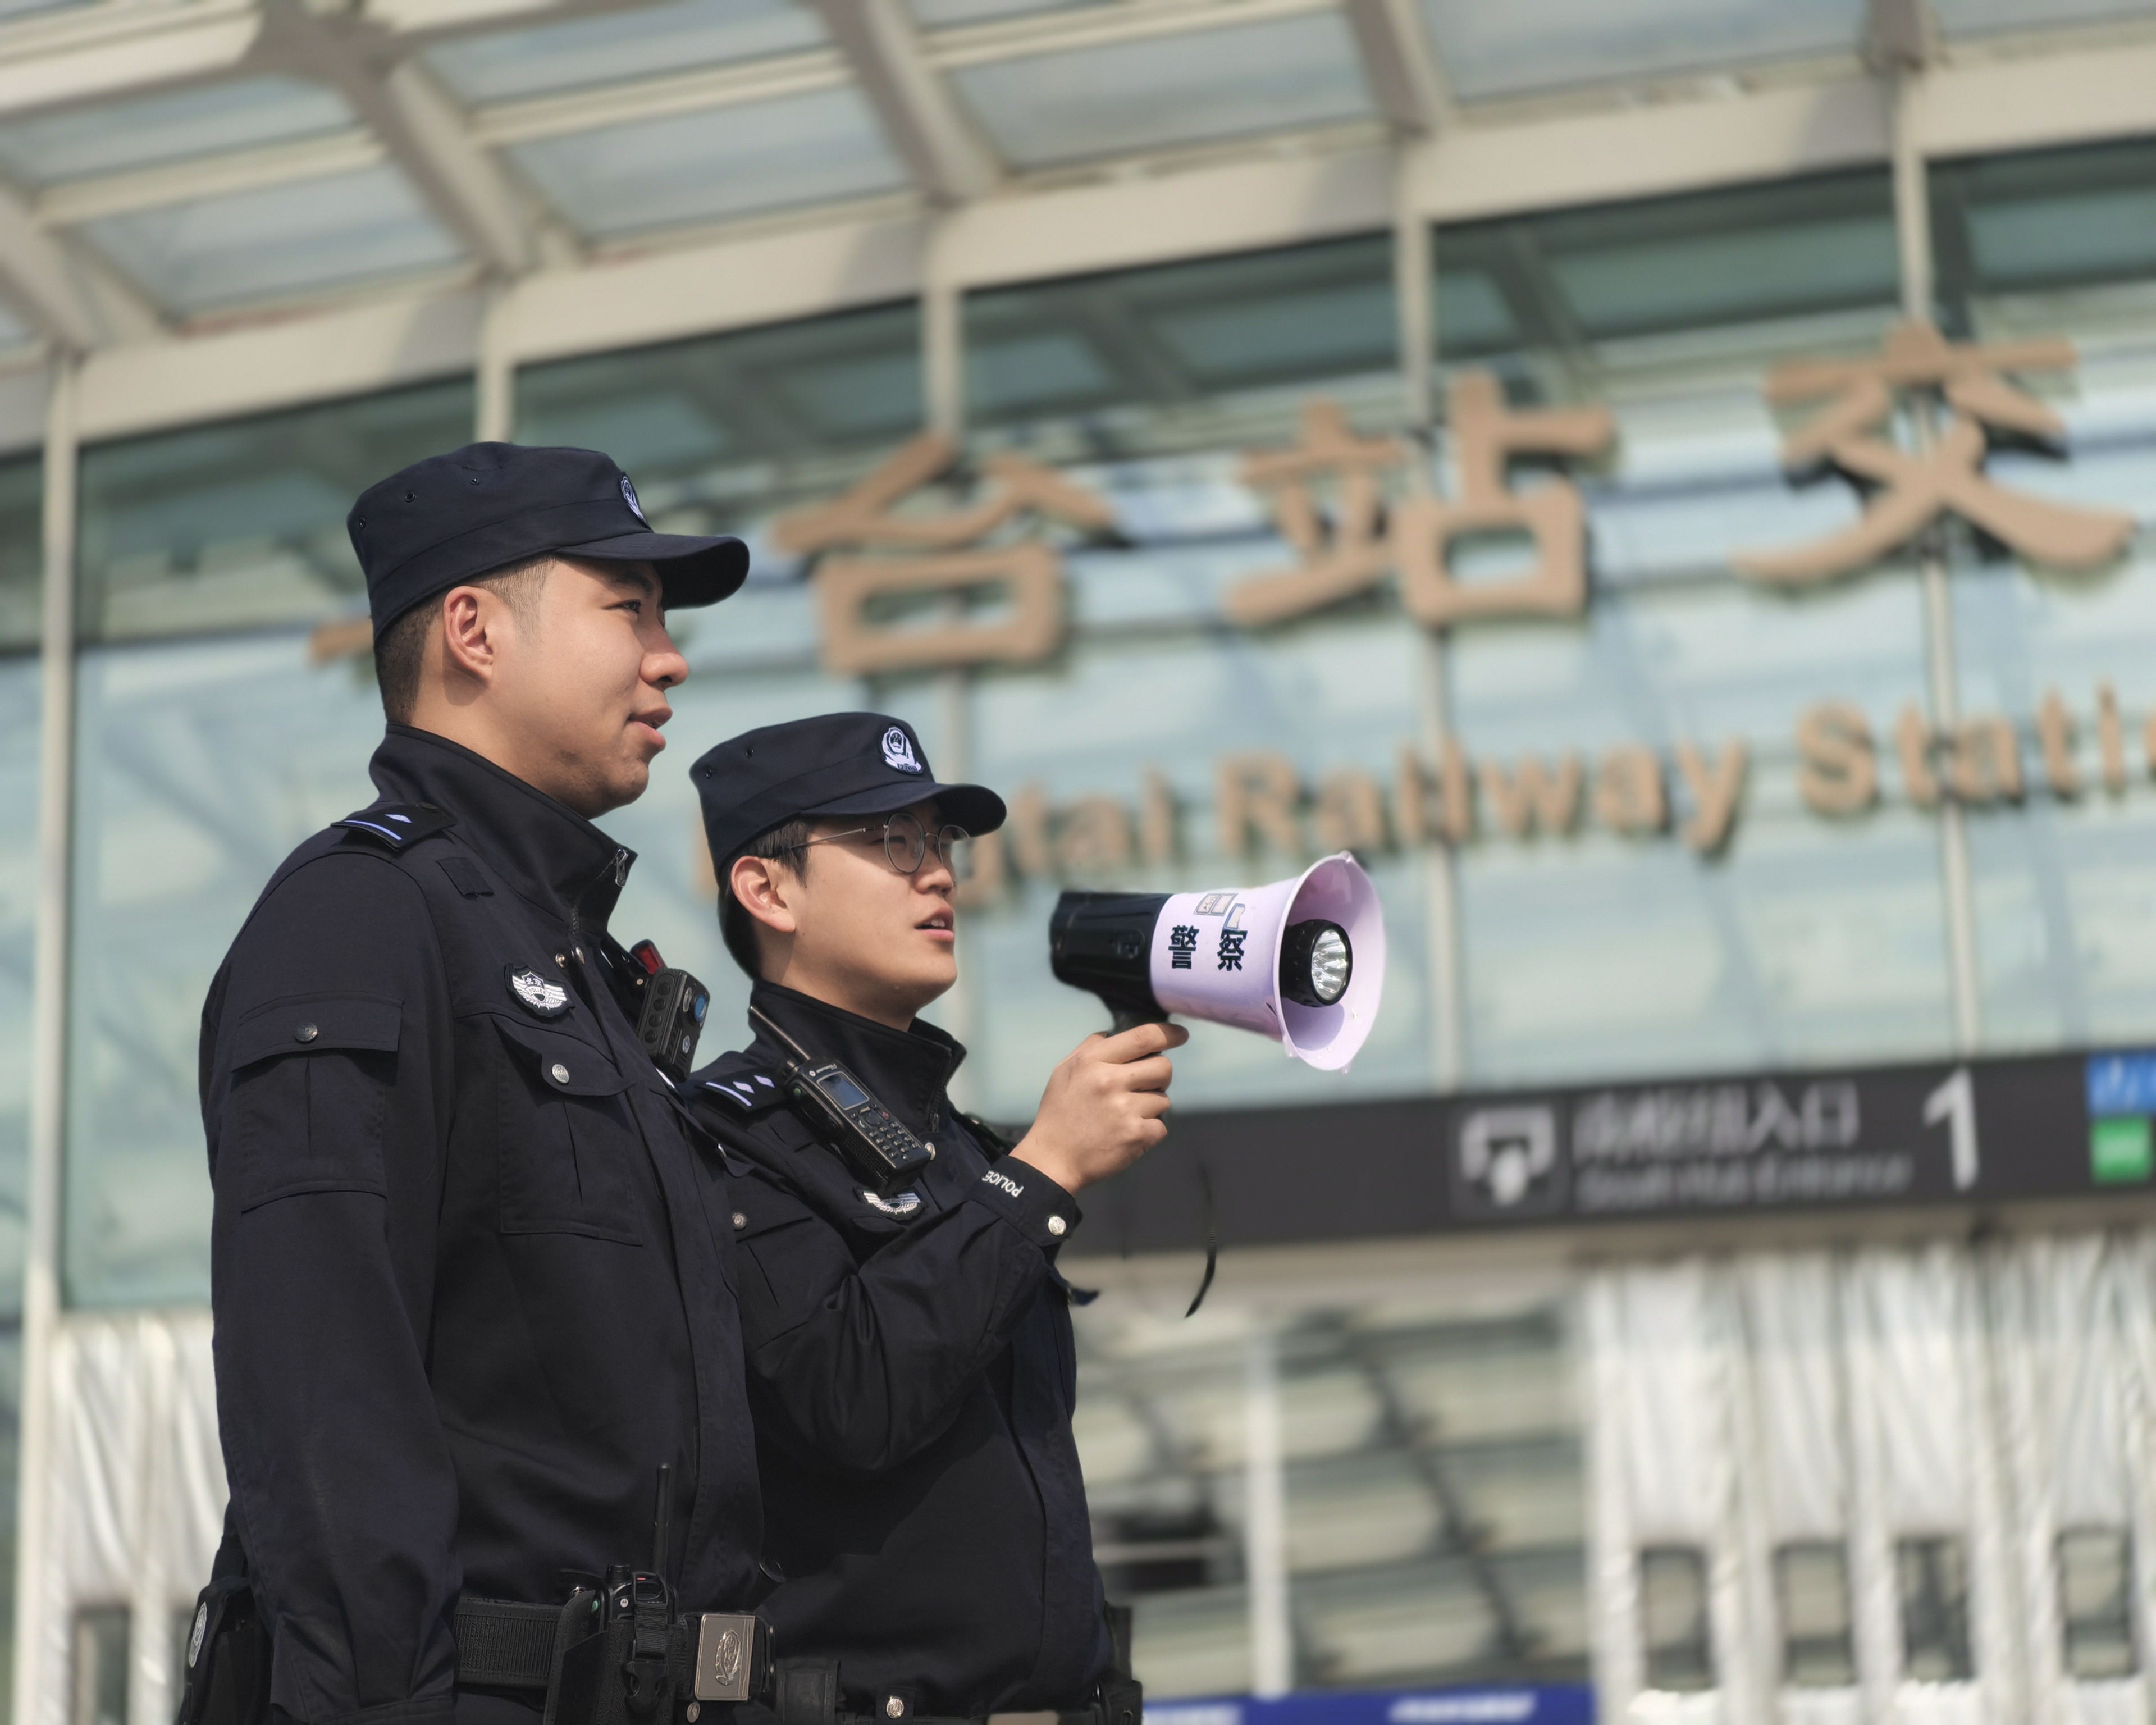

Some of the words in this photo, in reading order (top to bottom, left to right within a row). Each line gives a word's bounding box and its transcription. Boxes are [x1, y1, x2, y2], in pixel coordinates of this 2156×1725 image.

[310, 322, 2140, 677] 台站交
[1215, 732, 1747, 852] Railway
[1795, 678, 2156, 815] Stati
[1168, 925, 1248, 971] 警察
[981, 1170, 1024, 1197] POLICE
[1922, 1065, 1979, 1193] 1
